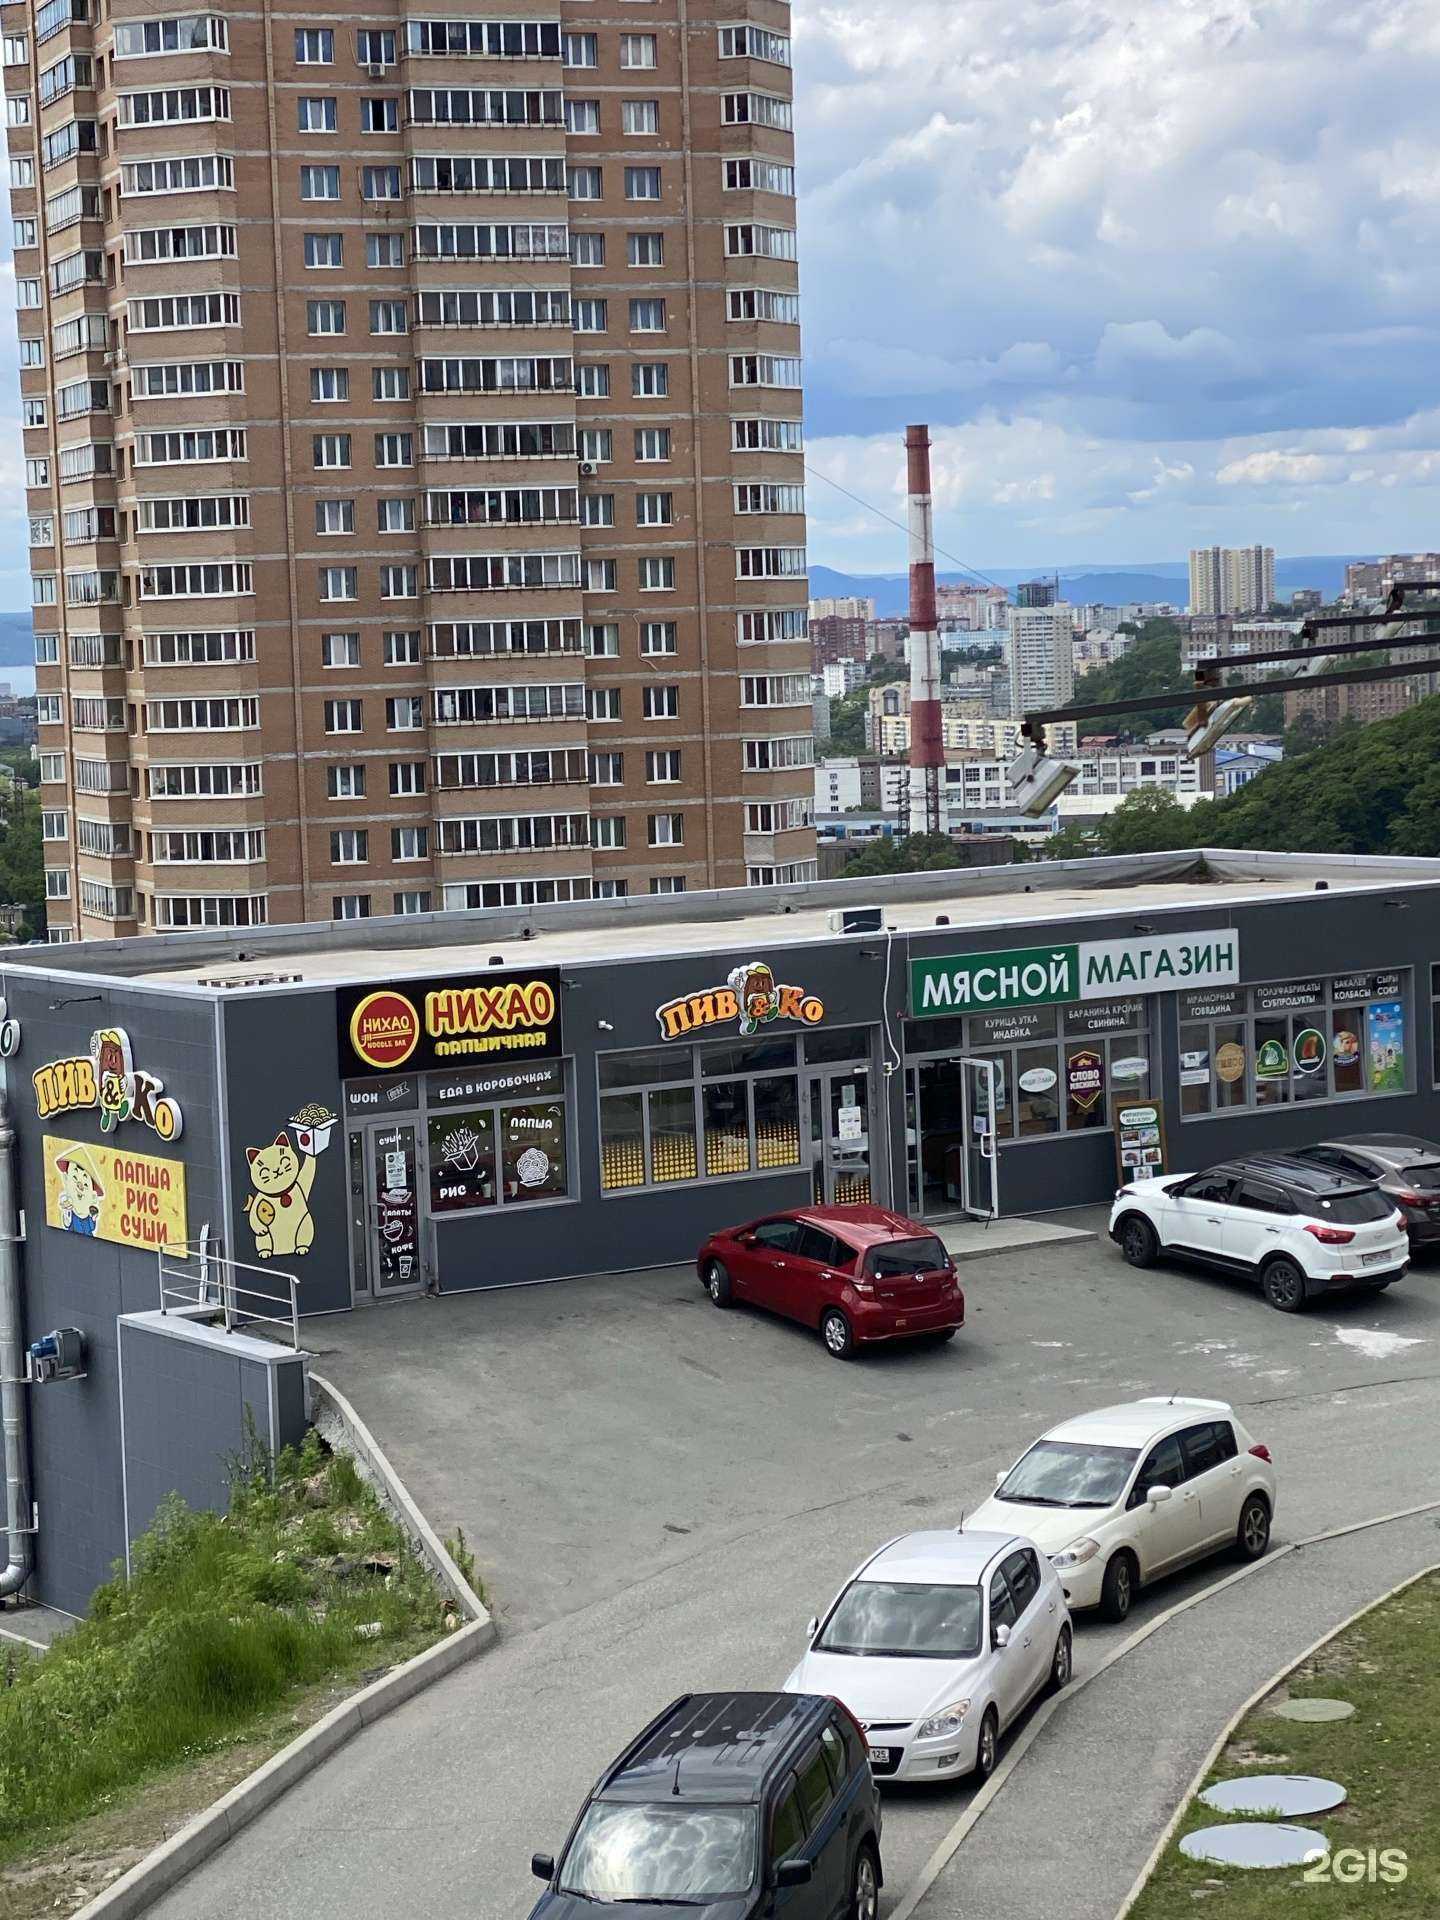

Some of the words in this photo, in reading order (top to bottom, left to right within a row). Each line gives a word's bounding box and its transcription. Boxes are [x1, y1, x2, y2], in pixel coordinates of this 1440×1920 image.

[922, 953, 1069, 1008] МЯСНОЙ
[1086, 942, 1233, 986] МАГАЗИН
[1376, 974, 1399, 984] СЫРЫ
[1257, 983, 1321, 997] ПОЛУФАБРИКАТЫ
[1334, 988, 1371, 1000] КОЛБАСЫ
[1377, 985, 1399, 996] СОКИ
[1186, 992, 1235, 1004] МРАМОРНАЯ
[1262, 995, 1316, 1008] СУБПРОДУКТЫ
[428, 983, 553, 1036] НИХАО
[661, 988, 740, 1038] ПИВ
[1068, 1007, 1110, 1019] БАРАНИНА
[1112, 1003, 1143, 1015] КРОЛИК
[1191, 1004, 1231, 1016] ГОВЯДИНА
[363, 1015, 410, 1033] НИХАО
[984, 1016, 1017, 1028] КУРИЦА
[1018, 1014, 1038, 1025] УТКА
[1087, 1016, 1125, 1029] СВИНИНА
[993, 1027, 1031, 1040] ИНДЕЙКА
[367, 1040, 393, 1049] NOODLE
[394, 1039, 407, 1048] BAR
[435, 1032, 547, 1056] ЛАПШИЧНАЯ
[1070, 1069, 1099, 1082] СЛОВО
[34, 1059, 97, 1118] ПИВ
[439, 1086, 463, 1099] ЕДА
[465, 1084, 473, 1095] В
[475, 1070, 552, 1093] КОРОБОЧКАХ
[510, 1116, 553, 1130] ЛАПША
[379, 1134, 402, 1146] СУШИ
[113, 1158, 171, 1192] ЛАПША
[439, 1184, 467, 1199] РИС
[126, 1187, 160, 1217] РИС
[120, 1213, 168, 1244] СУШИ
[391, 1242, 414, 1254] КОФЕ
[871, 1750, 885, 1759] 125
